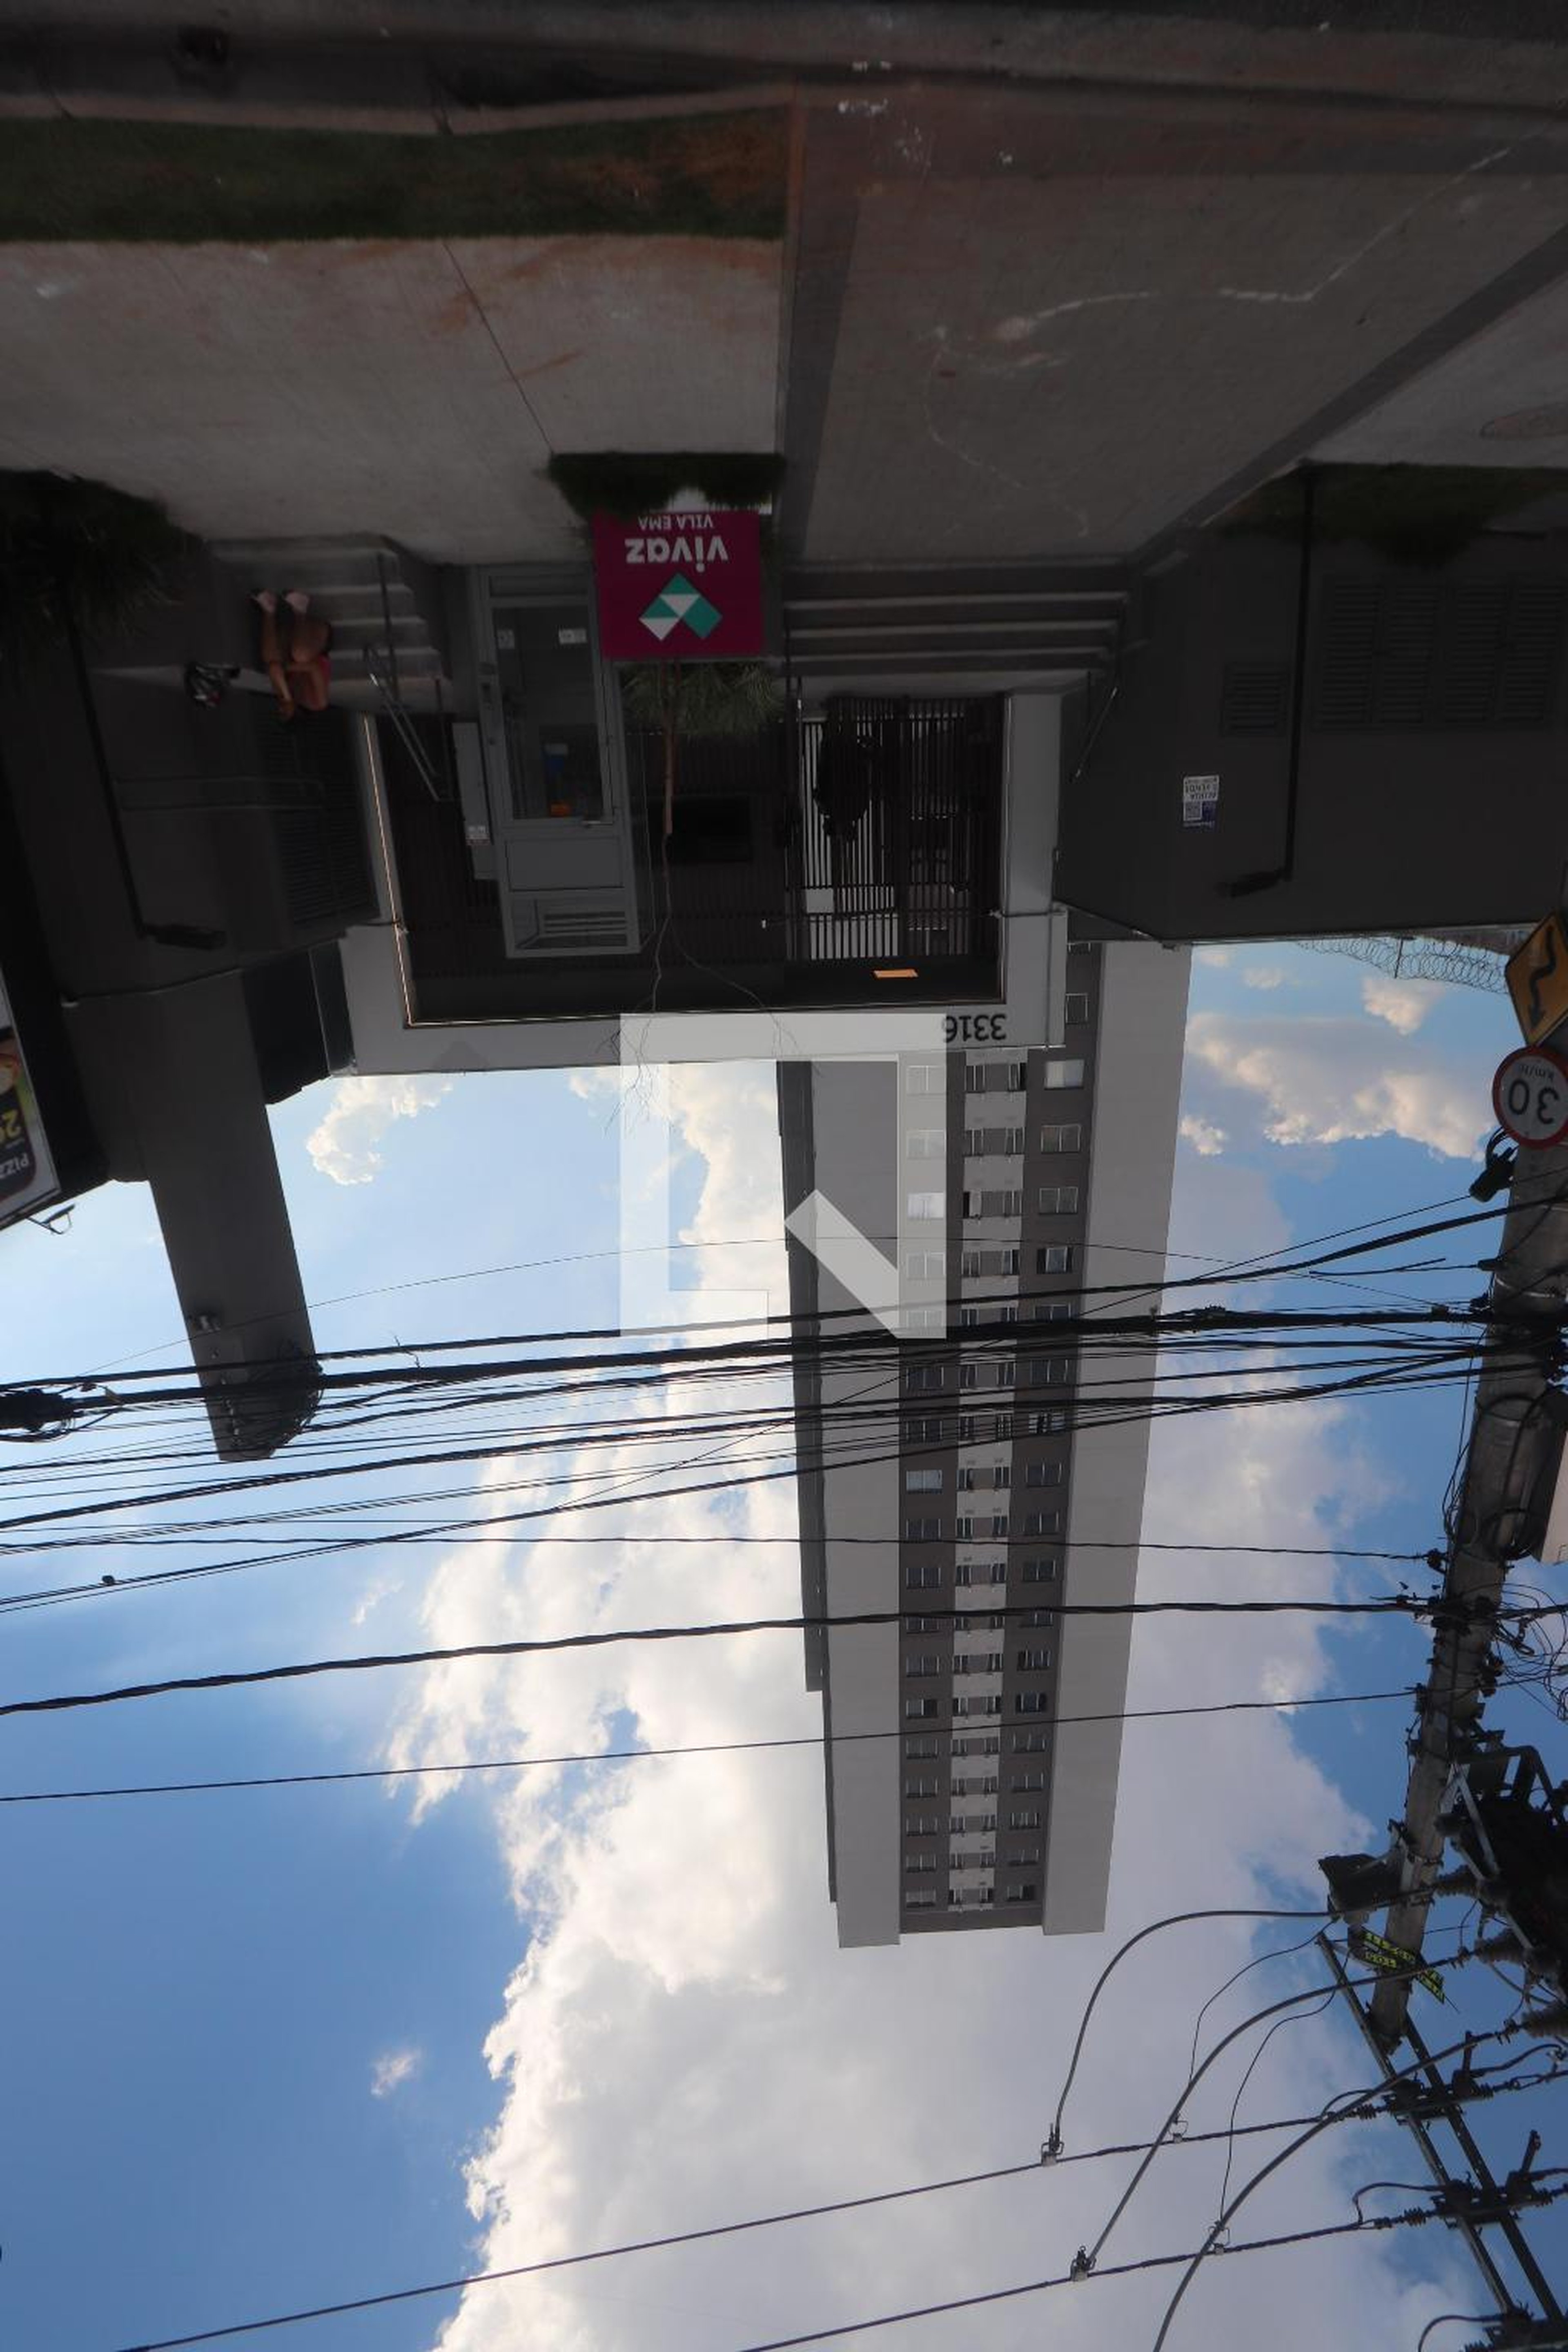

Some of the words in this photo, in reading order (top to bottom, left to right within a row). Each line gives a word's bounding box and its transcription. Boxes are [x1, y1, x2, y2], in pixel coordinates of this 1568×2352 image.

[638, 515, 671, 530] EMA
[676, 514, 713, 529] VILA
[625, 535, 729, 572] vivaz
[942, 1014, 1007, 1043] 3316
[1519, 1064, 1554, 1083] km/h
[1508, 1078, 1559, 1125] 30
